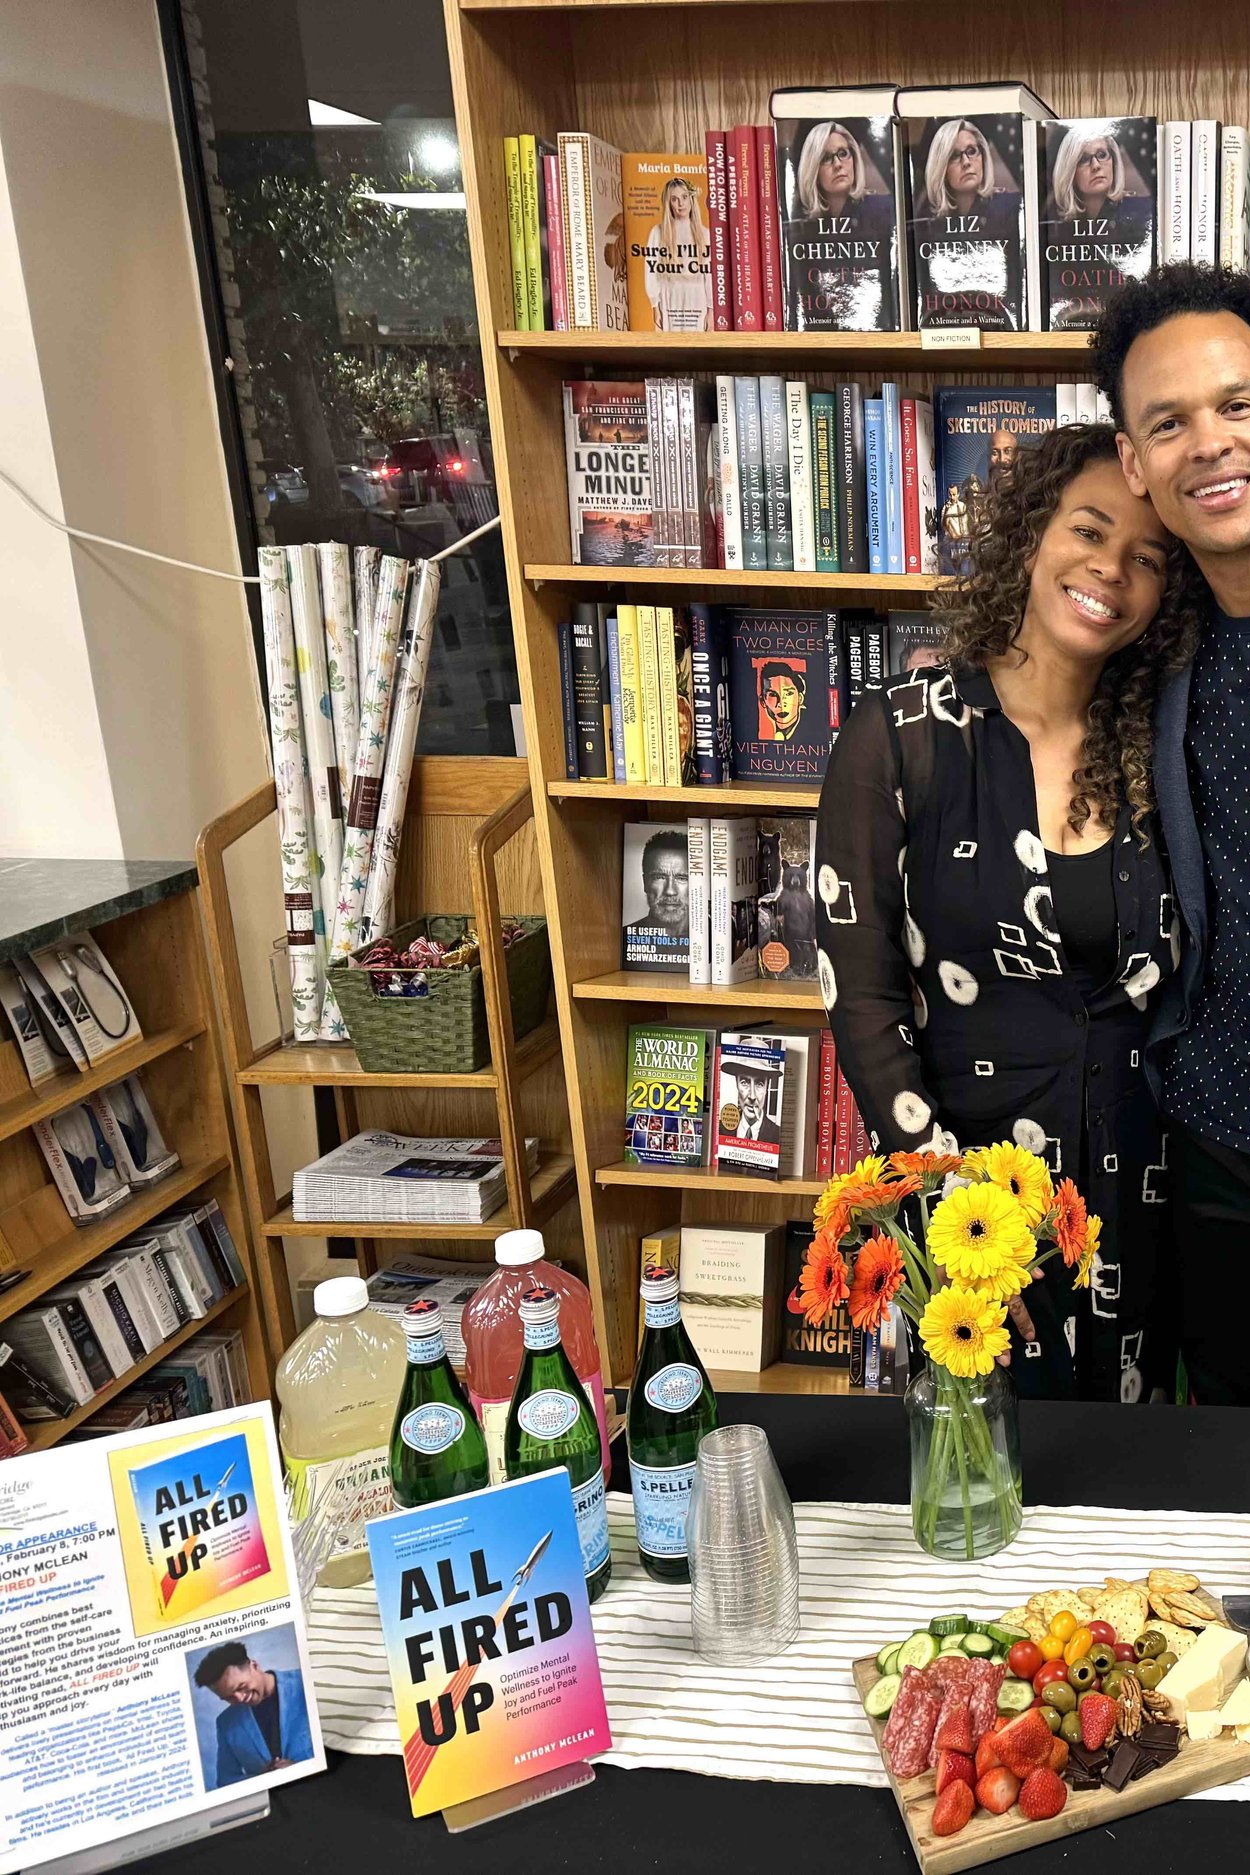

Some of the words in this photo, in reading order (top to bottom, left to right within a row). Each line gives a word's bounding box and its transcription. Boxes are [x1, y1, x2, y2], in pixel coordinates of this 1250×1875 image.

[818, 217, 851, 234] LIZ
[631, 244, 672, 260] Sure,
[677, 244, 698, 258] I'll
[793, 242, 880, 258] CHENEY
[646, 260, 682, 274] Your
[843, 387, 852, 429] GEORGE
[980, 400, 1026, 414] HISTORY
[1028, 405, 1036, 413] OF
[948, 419, 997, 434] SKETCH
[1001, 418, 1056, 432] COMEDY
[844, 431, 853, 484] HARRISON
[750, 465, 759, 498] DAVID
[751, 502, 762, 544] GRANN
[739, 620, 752, 631] A
[754, 620, 790, 632] MAN
[796, 621, 818, 633] OF
[734, 635, 772, 649] TWO
[777, 636, 823, 650] FACES
[693, 652, 710, 693] ONCE
[695, 699, 711, 708] A
[696, 714, 713, 757] GIANT
[750, 758, 817, 771] NGUYEN
[627, 927, 637, 935] BE
[638, 927, 668, 937] USEFUL
[627, 944, 656, 953] ARNOLD
[643, 1039, 698, 1056] WORLD
[634, 1056, 698, 1071] ALMANAC
[632, 1081, 698, 1113] 2024
[695, 1273, 746, 1282] SWEETGRASS
[701, 1260, 741, 1268] BRAIDING
[156, 1474, 211, 1516] ALL
[26, 1522, 97, 1548] APPEARANCE
[159, 1493, 247, 1549] FIRED
[6, 1544, 56, 1563] February
[59, 1541, 70, 1550] 8,
[73, 1534, 96, 1546] 7:00
[99, 1528, 115, 1539] PM
[34, 1552, 88, 1573] MCLEAN
[167, 1543, 208, 1580] UP
[400, 1549, 502, 1620] ALL
[154, 1625, 200, 1644] managing
[203, 1616, 239, 1630] anxiety,
[242, 1600, 291, 1621] prioritizing
[405, 1591, 573, 1684] FIRED
[500, 1664, 538, 1684] Optimize
[540, 1653, 570, 1670] Mental
[502, 1676, 540, 1696] Wellness
[542, 1672, 551, 1682] to
[552, 1664, 577, 1682] Ignite
[504, 1696, 518, 1709] Joy
[519, 1690, 536, 1703] and
[537, 1684, 556, 1697] Fuel
[558, 1677, 577, 1692] Peak
[416, 1682, 495, 1746] UP
[506, 1695, 561, 1721] Performance
[515, 1744, 556, 1764] ANTHONY
[560, 1729, 594, 1747] MCLEAN
